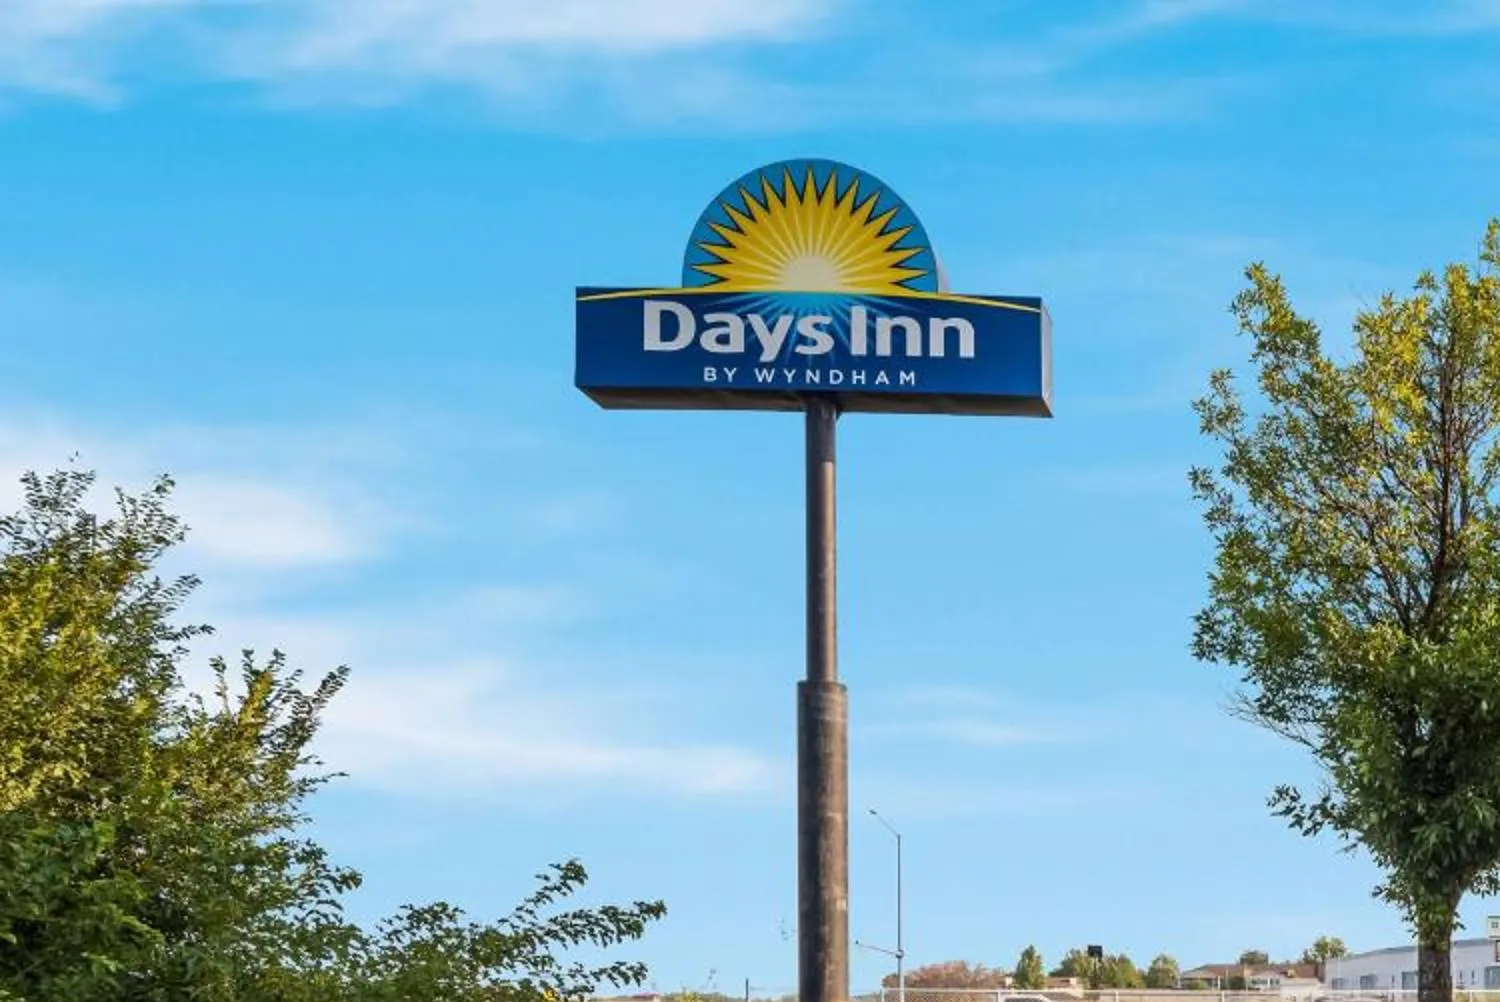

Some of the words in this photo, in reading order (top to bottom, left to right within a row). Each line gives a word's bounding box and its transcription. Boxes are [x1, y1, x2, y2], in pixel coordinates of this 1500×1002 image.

[643, 300, 834, 362] Days
[851, 305, 975, 358] Inn
[703, 367, 737, 382] BY
[755, 368, 915, 385] WYNDHAM
